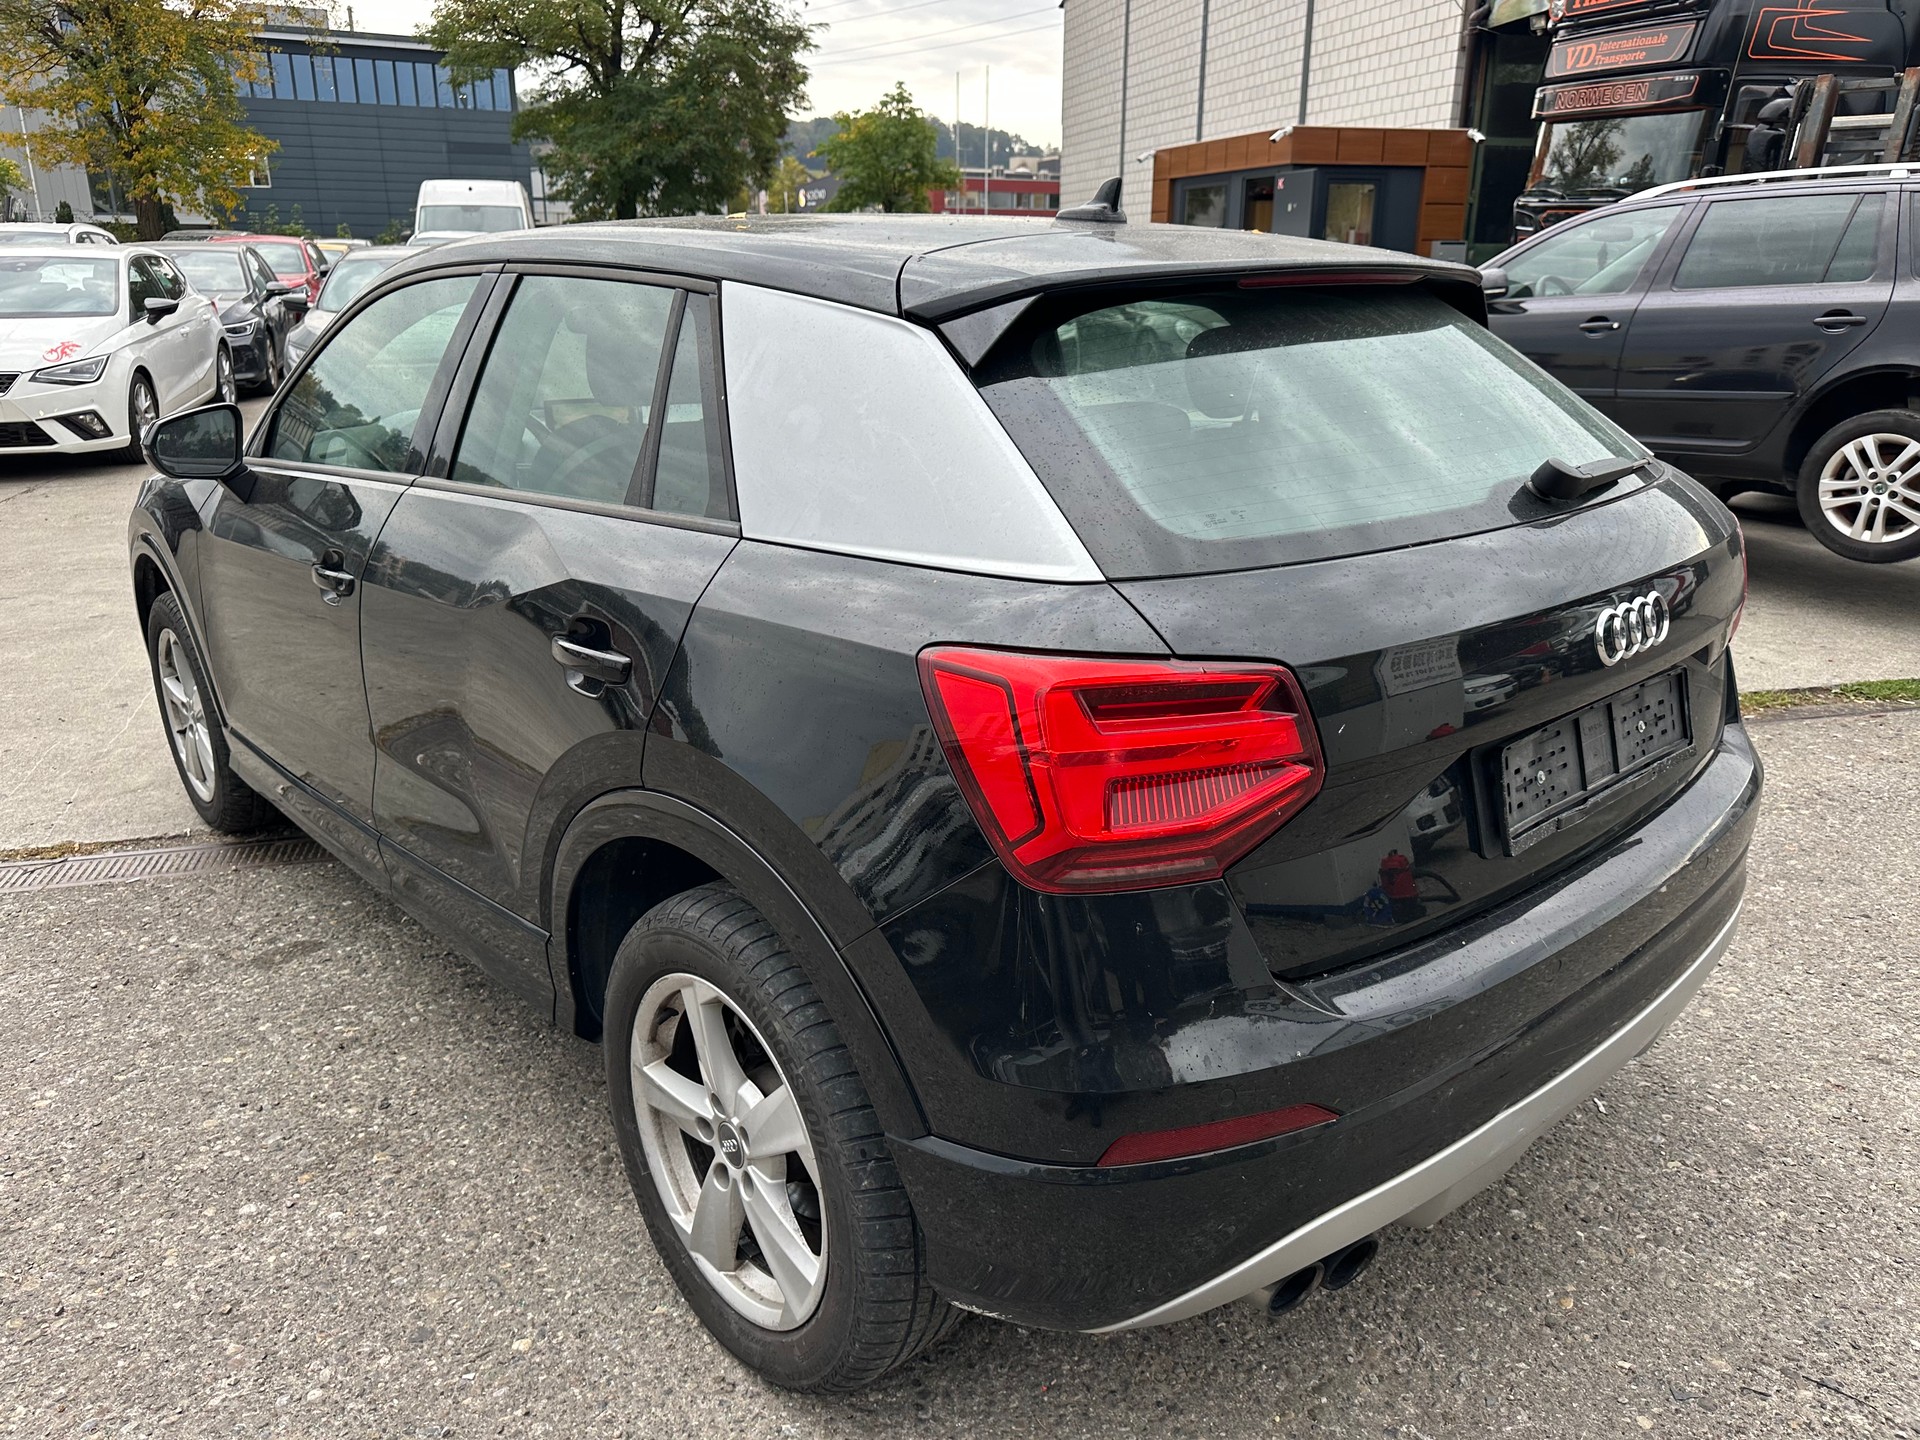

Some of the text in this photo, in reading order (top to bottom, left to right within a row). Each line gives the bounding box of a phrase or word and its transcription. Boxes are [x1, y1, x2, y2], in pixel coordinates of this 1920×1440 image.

[1599, 32, 1668, 50] Internationale
[1566, 43, 1597, 70] VD
[1594, 51, 1646, 65] Transporte
[1554, 82, 1650, 110] NORWEGEN
[733, 976, 835, 1169] BRIDGESTONE
